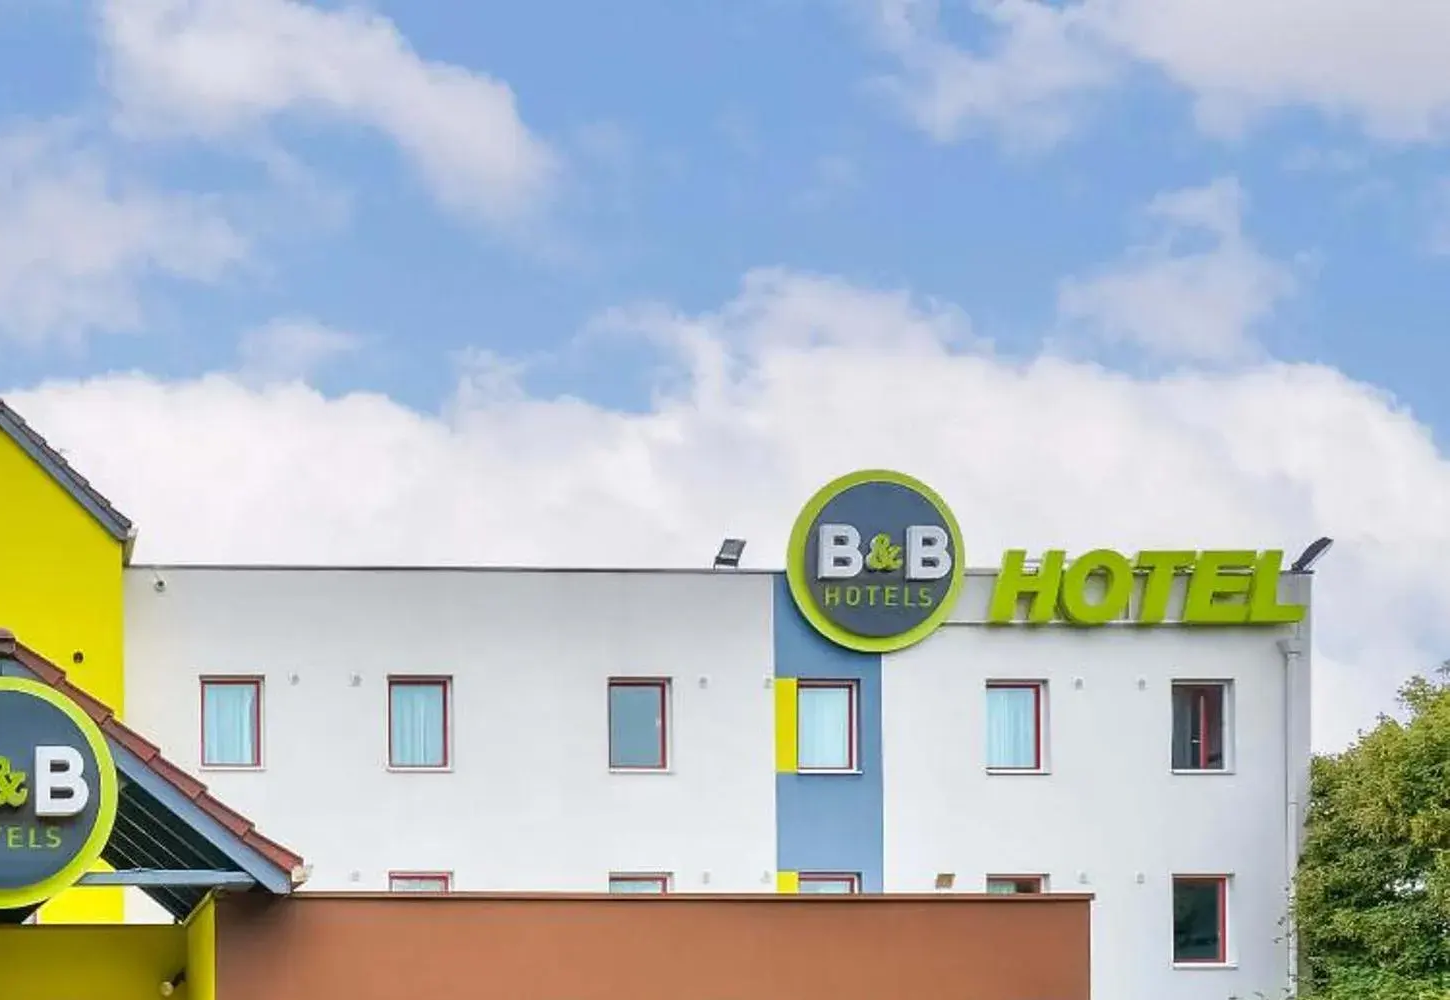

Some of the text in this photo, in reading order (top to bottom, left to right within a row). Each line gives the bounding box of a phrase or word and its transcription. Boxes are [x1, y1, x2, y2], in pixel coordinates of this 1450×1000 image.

[818, 524, 951, 580] B&B
[824, 585, 933, 608] HOTELS
[987, 549, 1307, 626] HOTEL
